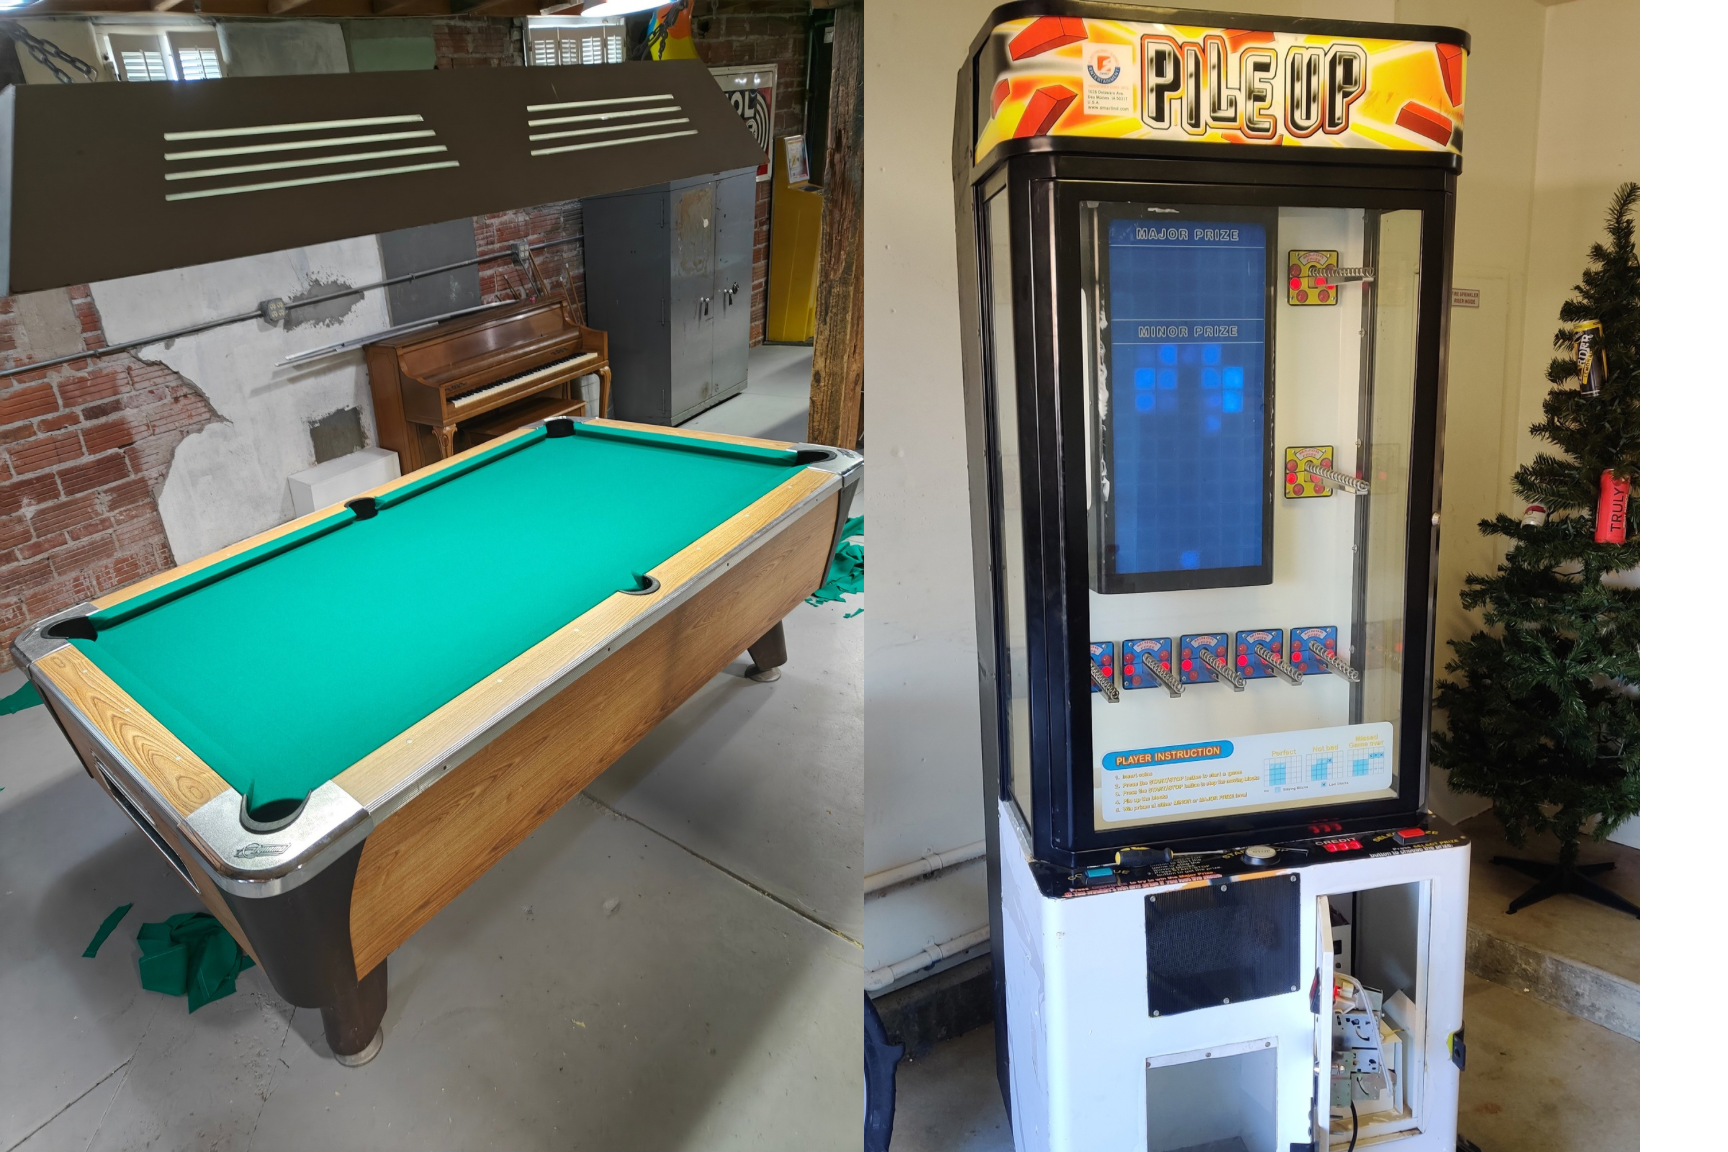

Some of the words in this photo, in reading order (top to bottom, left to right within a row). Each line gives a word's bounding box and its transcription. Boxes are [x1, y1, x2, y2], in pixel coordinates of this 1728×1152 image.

[1142, 35, 1277, 138] PILE
[1285, 42, 1367, 138] UP
[1136, 228, 1189, 240] MAJOR
[1194, 229, 1239, 241] PRIZE
[1138, 326, 1188, 338] MINOR
[1194, 326, 1238, 337] PRIZE
[1610, 488, 1624, 532] TRULY
[1116, 754, 1152, 766] PLAYER
[1155, 746, 1221, 761] INSTRUCTION
[1272, 749, 1297, 757] Perfect
[1315, 837, 1356, 846] CREDIT
